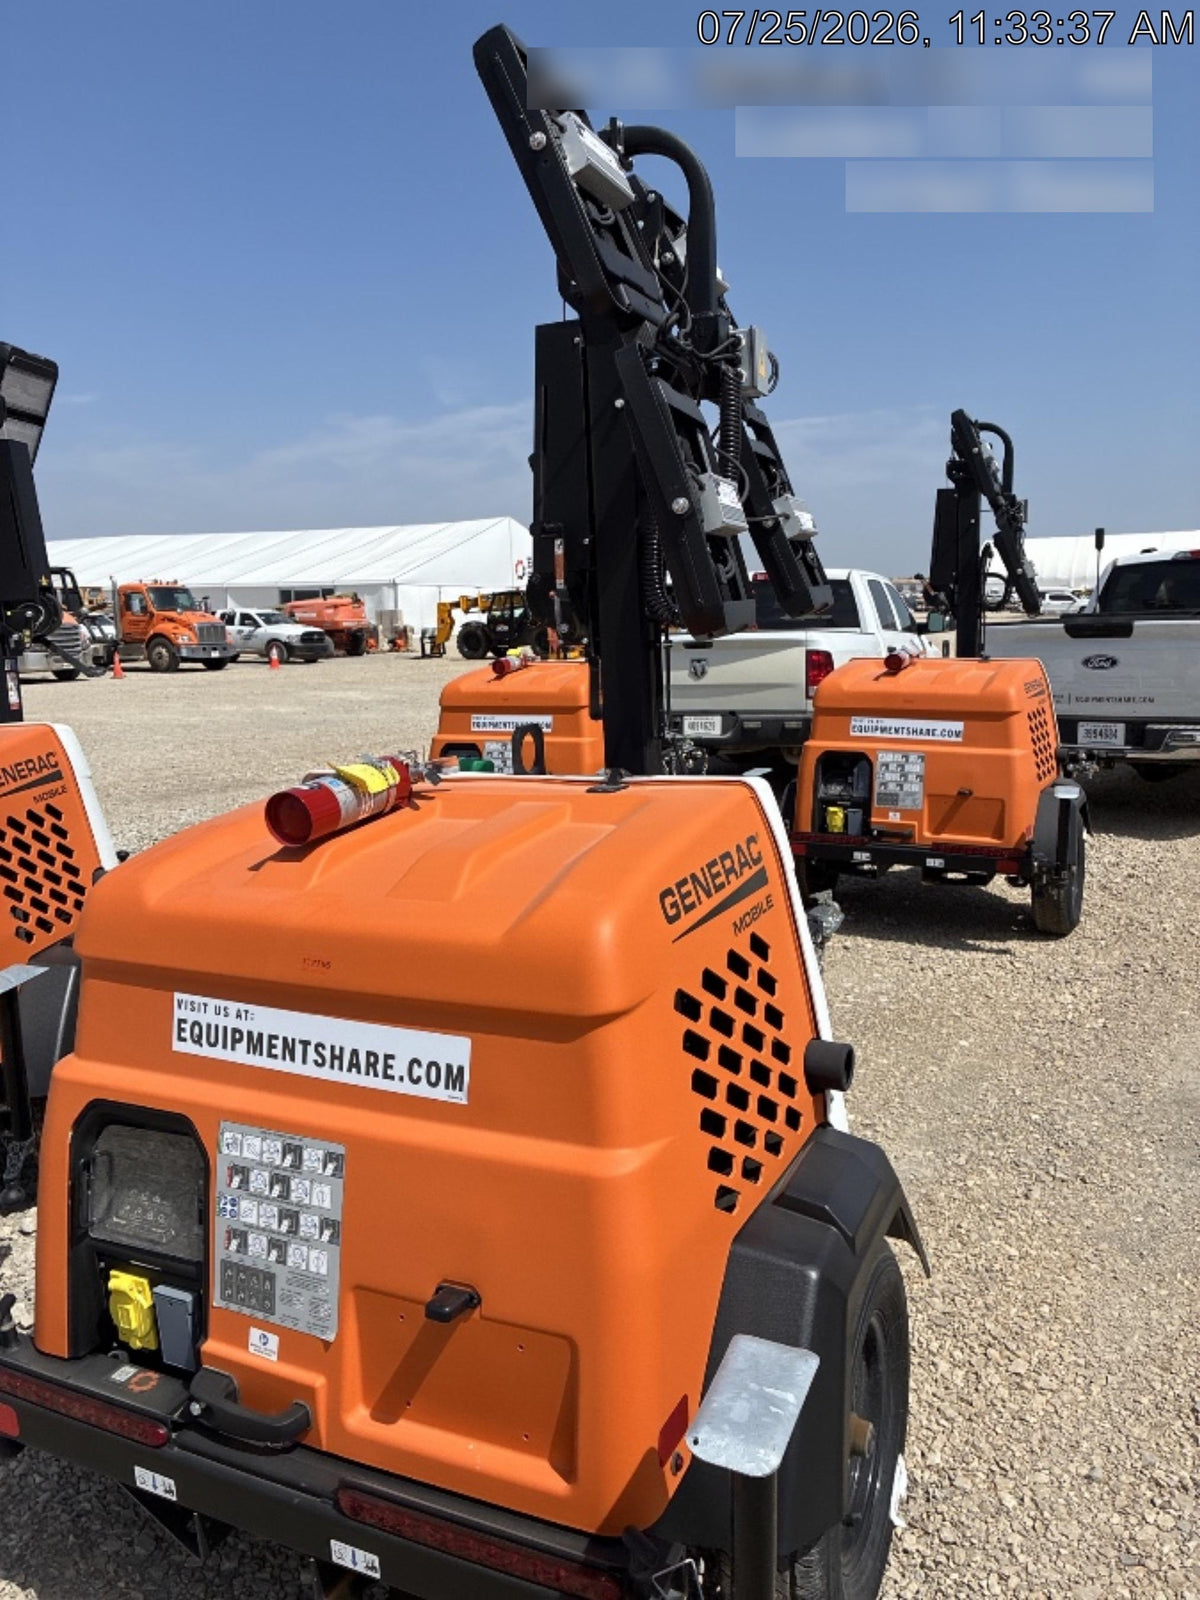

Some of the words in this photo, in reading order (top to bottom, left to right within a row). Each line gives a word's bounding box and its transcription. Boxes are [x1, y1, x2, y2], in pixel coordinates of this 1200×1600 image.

[1087, 657, 1112, 668] Ford
[851, 725, 962, 739] EQUIPMENTSHARE.COM
[33, 784, 67, 804] MOBILE
[659, 835, 763, 925] GENERAC
[732, 893, 774, 937] MOBILE
[177, 998, 208, 1014] VISIT
[214, 1004, 230, 1018] US
[236, 1008, 255, 1021] AT:
[177, 1018, 465, 1092] EQUIPMENTSHARE.COM
